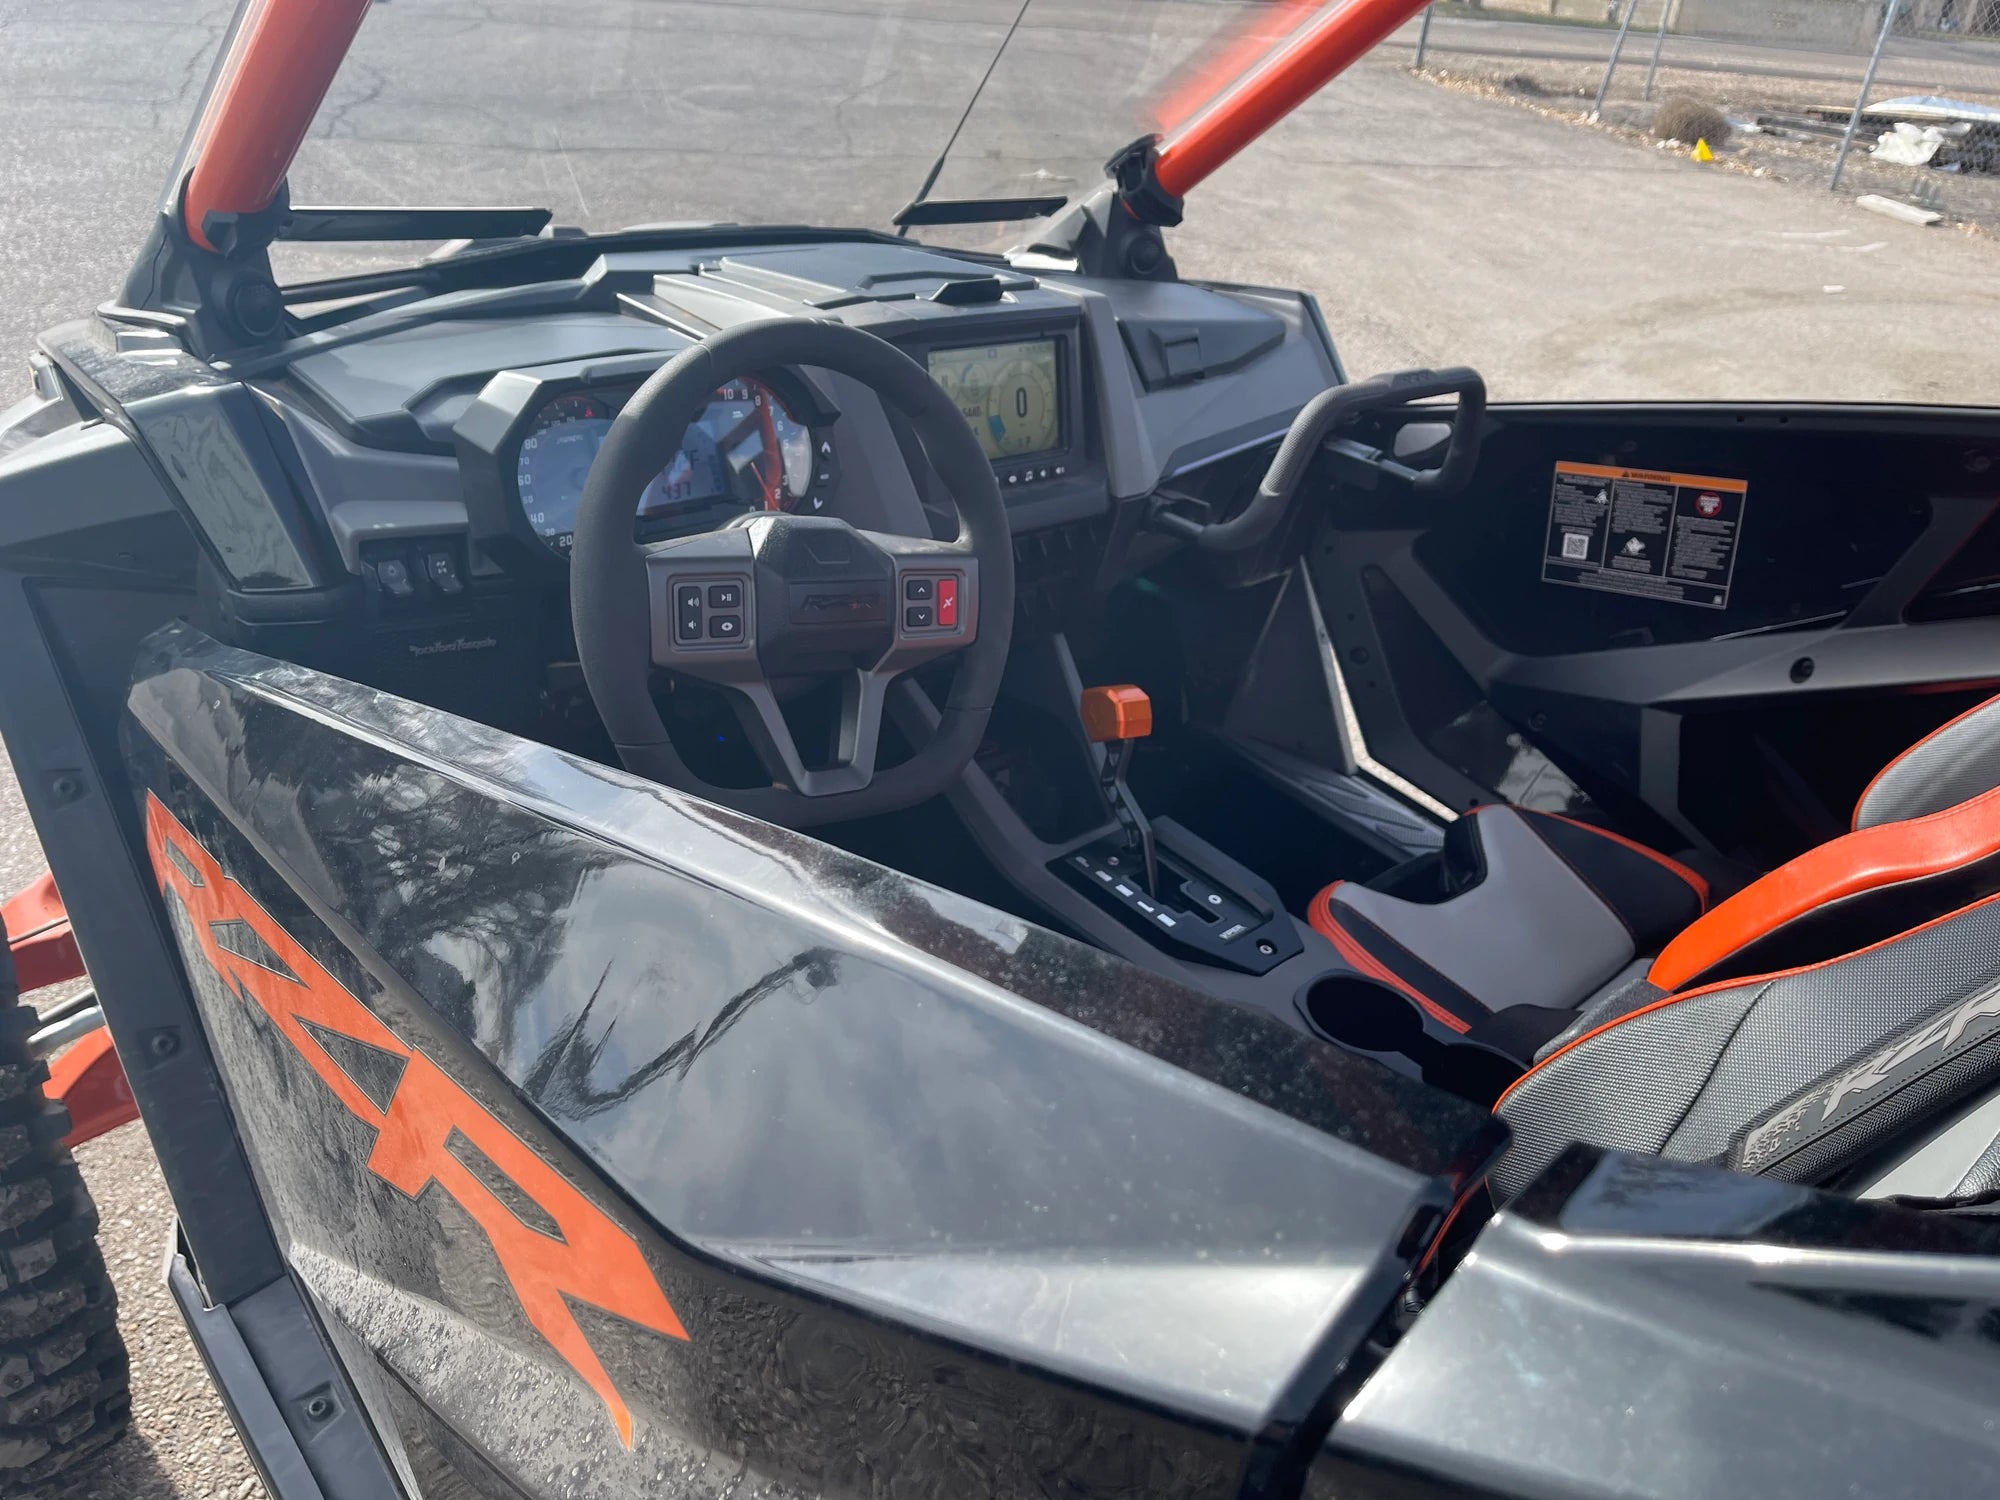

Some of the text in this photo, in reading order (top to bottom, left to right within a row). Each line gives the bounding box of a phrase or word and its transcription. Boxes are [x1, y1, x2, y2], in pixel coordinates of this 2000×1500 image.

[723, 389, 734, 400] 10
[742, 389, 748, 400] 9
[755, 395, 761, 406] 8
[1016, 387, 1027, 418] 0
[777, 421, 783, 431] 6
[524, 438, 538, 450] 80
[517, 474, 531, 486] 60
[782, 475, 788, 485] 3
[1631, 470, 1671, 484] WARNING
[774, 488, 781, 499] 2
[530, 512, 544, 524] 40
[559, 535, 573, 547] 20
